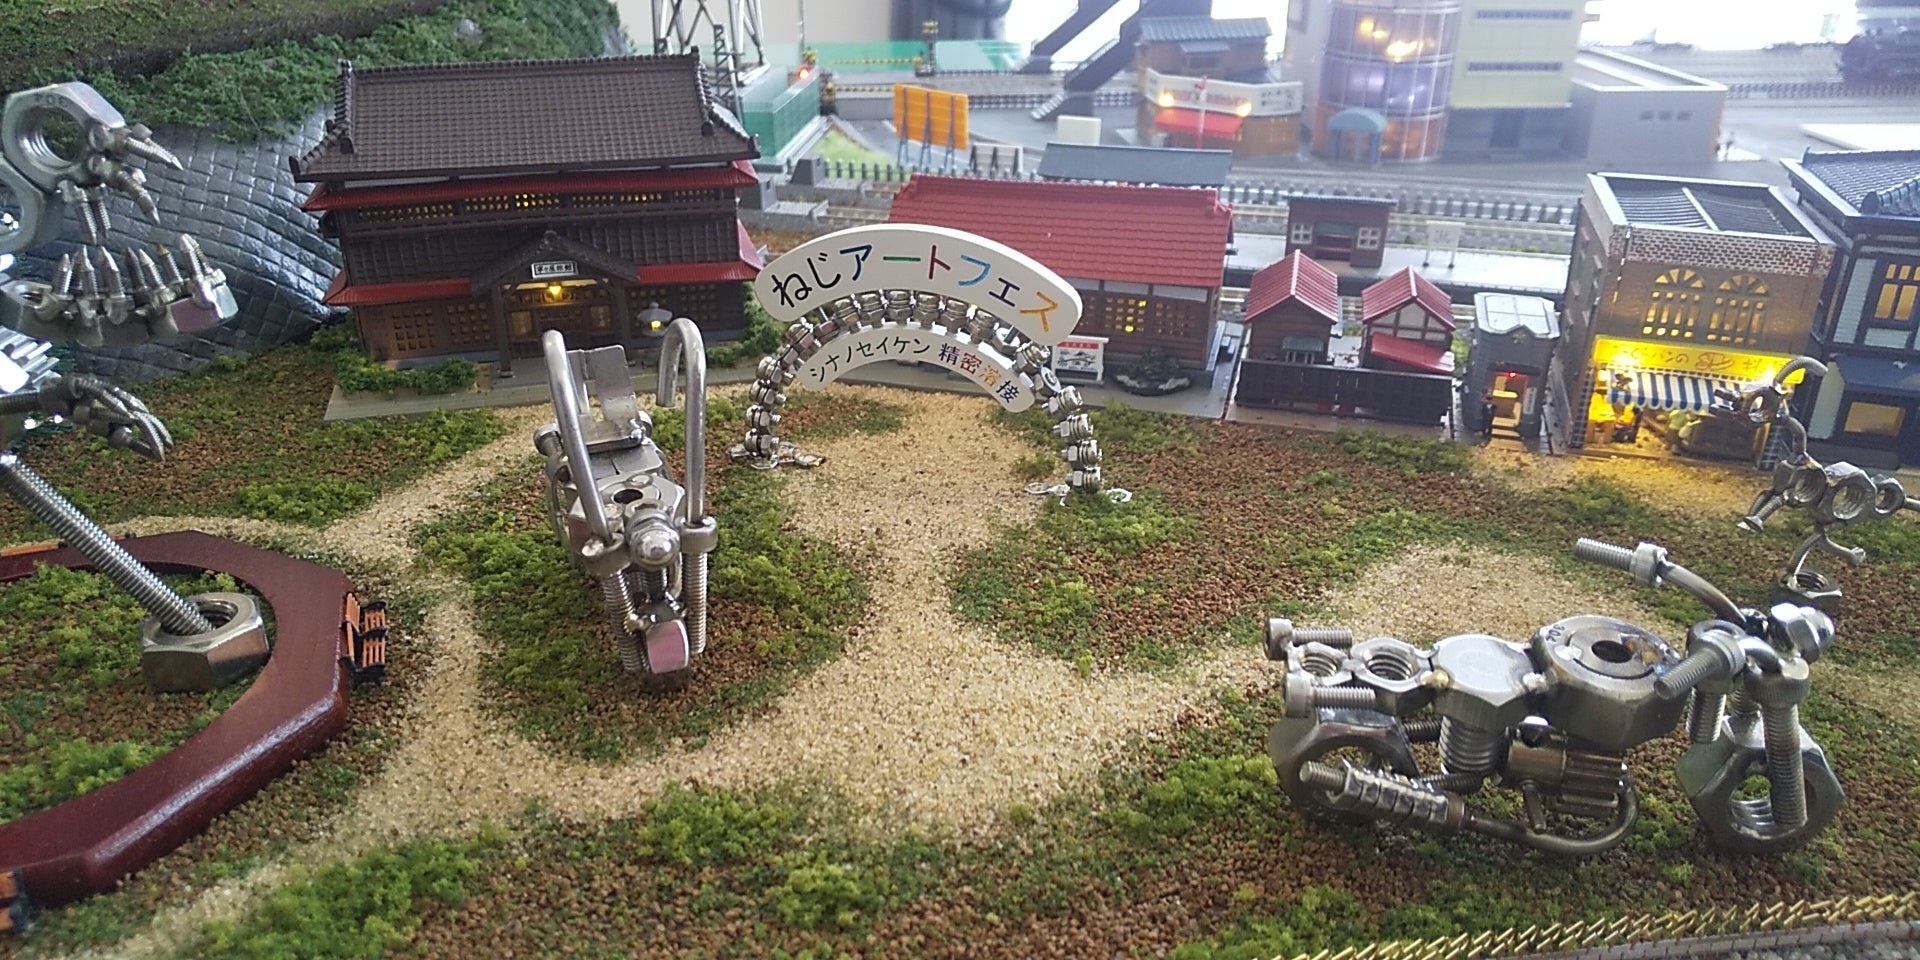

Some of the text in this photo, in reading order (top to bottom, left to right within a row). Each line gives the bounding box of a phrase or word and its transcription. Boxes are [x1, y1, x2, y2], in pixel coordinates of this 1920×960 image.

[771, 244, 1059, 332] ねじアートフェス
[810, 336, 1020, 404] シナノセイケン 精密溶接
